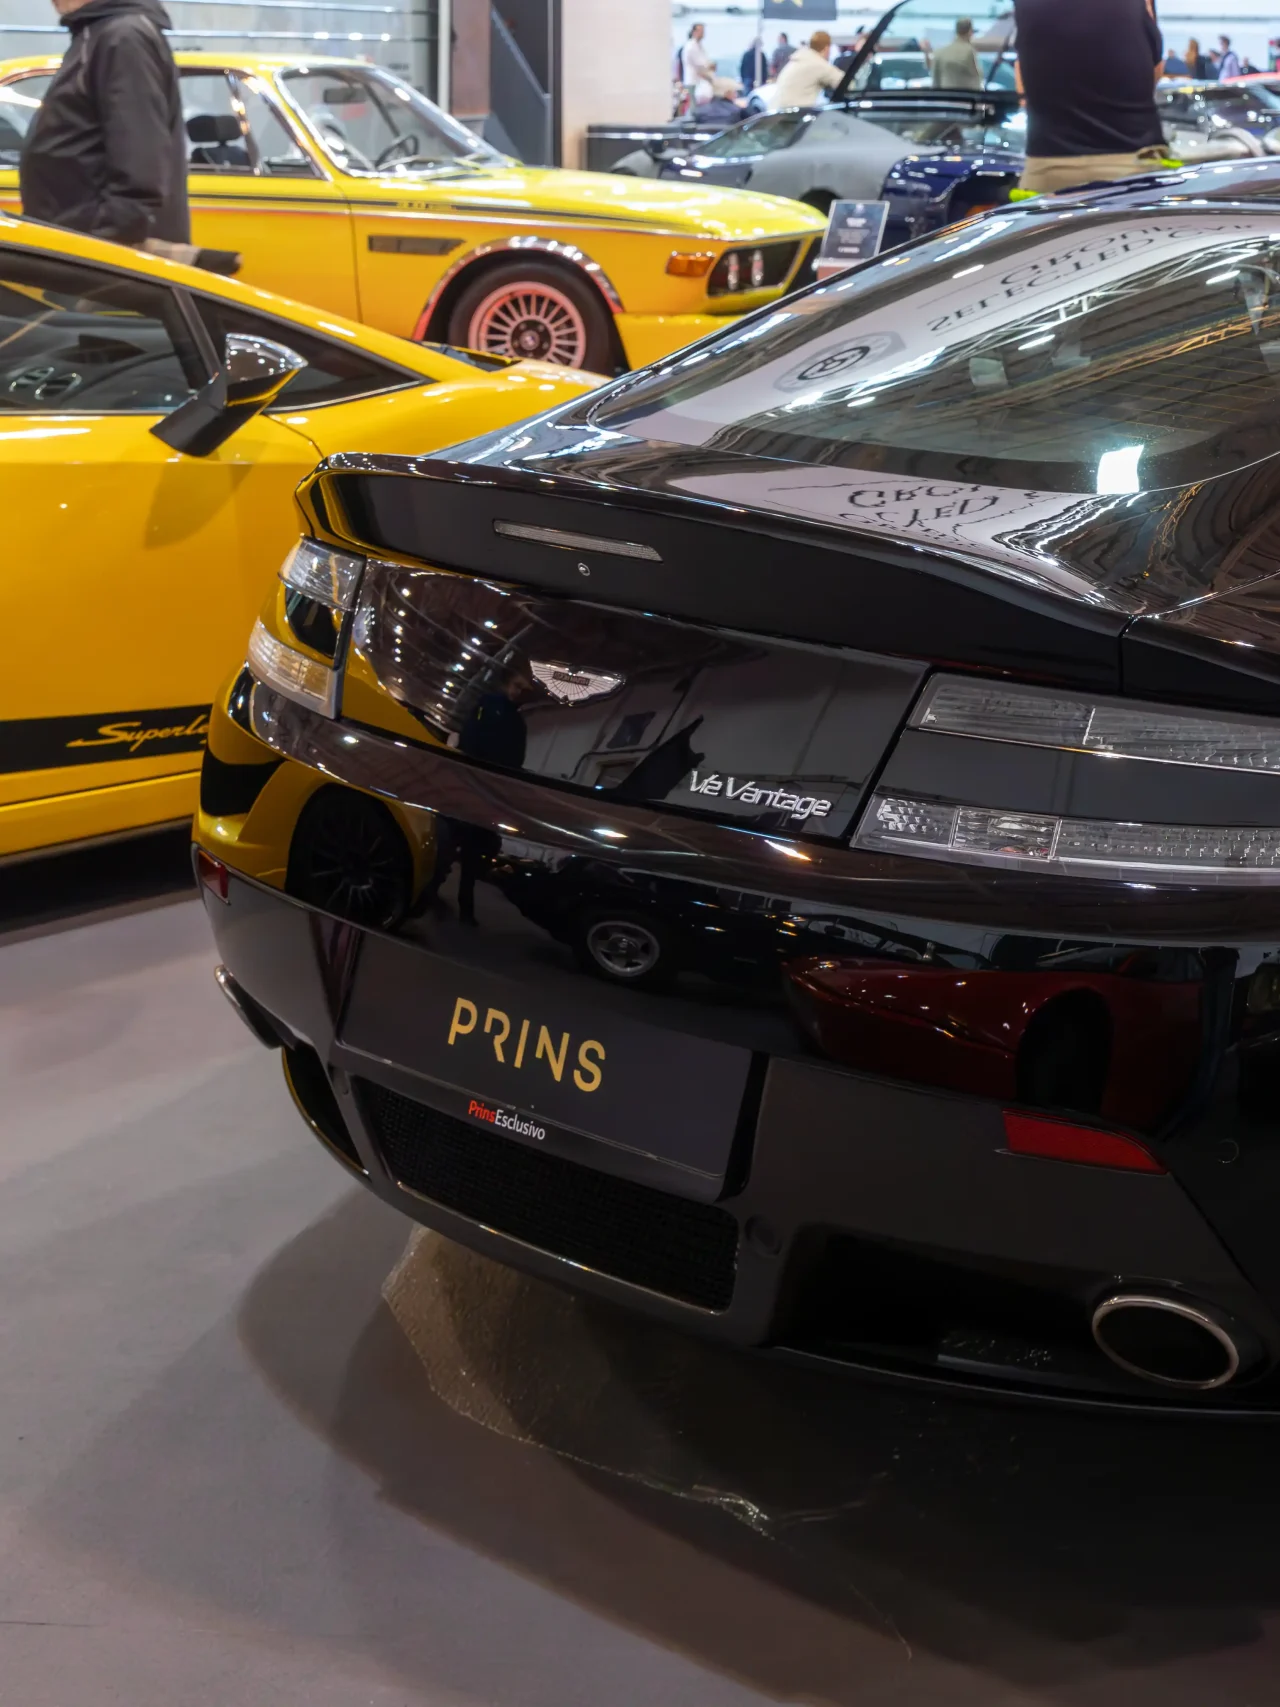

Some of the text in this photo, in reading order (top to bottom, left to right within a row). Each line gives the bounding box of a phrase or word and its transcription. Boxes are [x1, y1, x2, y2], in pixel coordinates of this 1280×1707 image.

[66, 714, 209, 752] Superle
[689, 770, 832, 820] V12 Vantage
[447, 997, 606, 1092] PRINS
